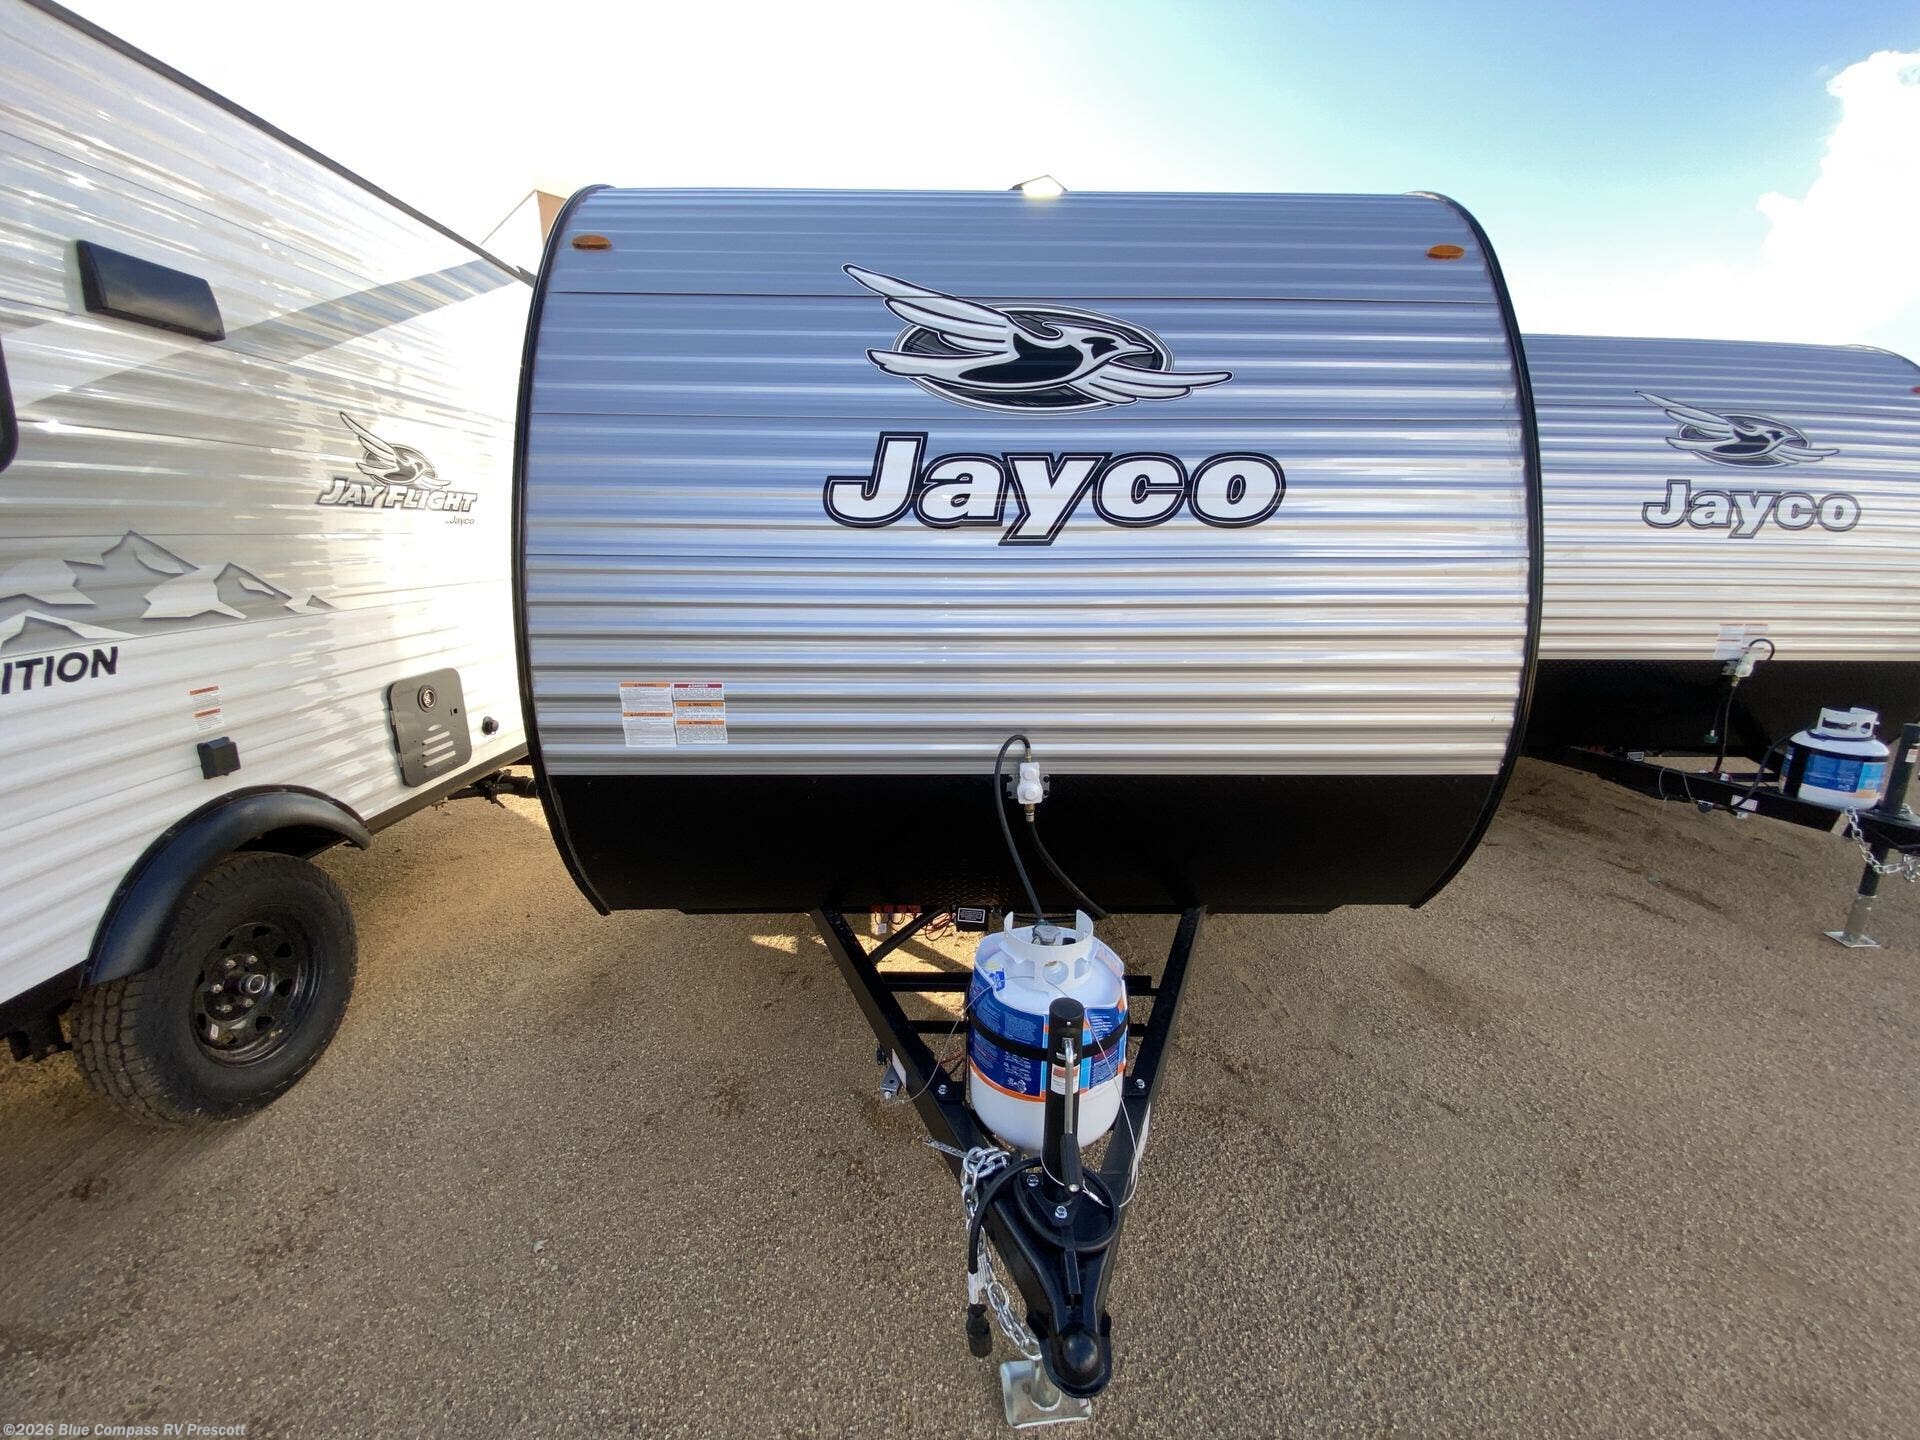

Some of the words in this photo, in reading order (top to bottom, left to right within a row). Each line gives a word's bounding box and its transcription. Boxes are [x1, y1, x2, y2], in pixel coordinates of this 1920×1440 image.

[317, 476, 385, 507] JAY
[382, 484, 479, 512] FLIGHT
[822, 431, 1287, 546] Jayco
[1641, 479, 1862, 539] Jayco
